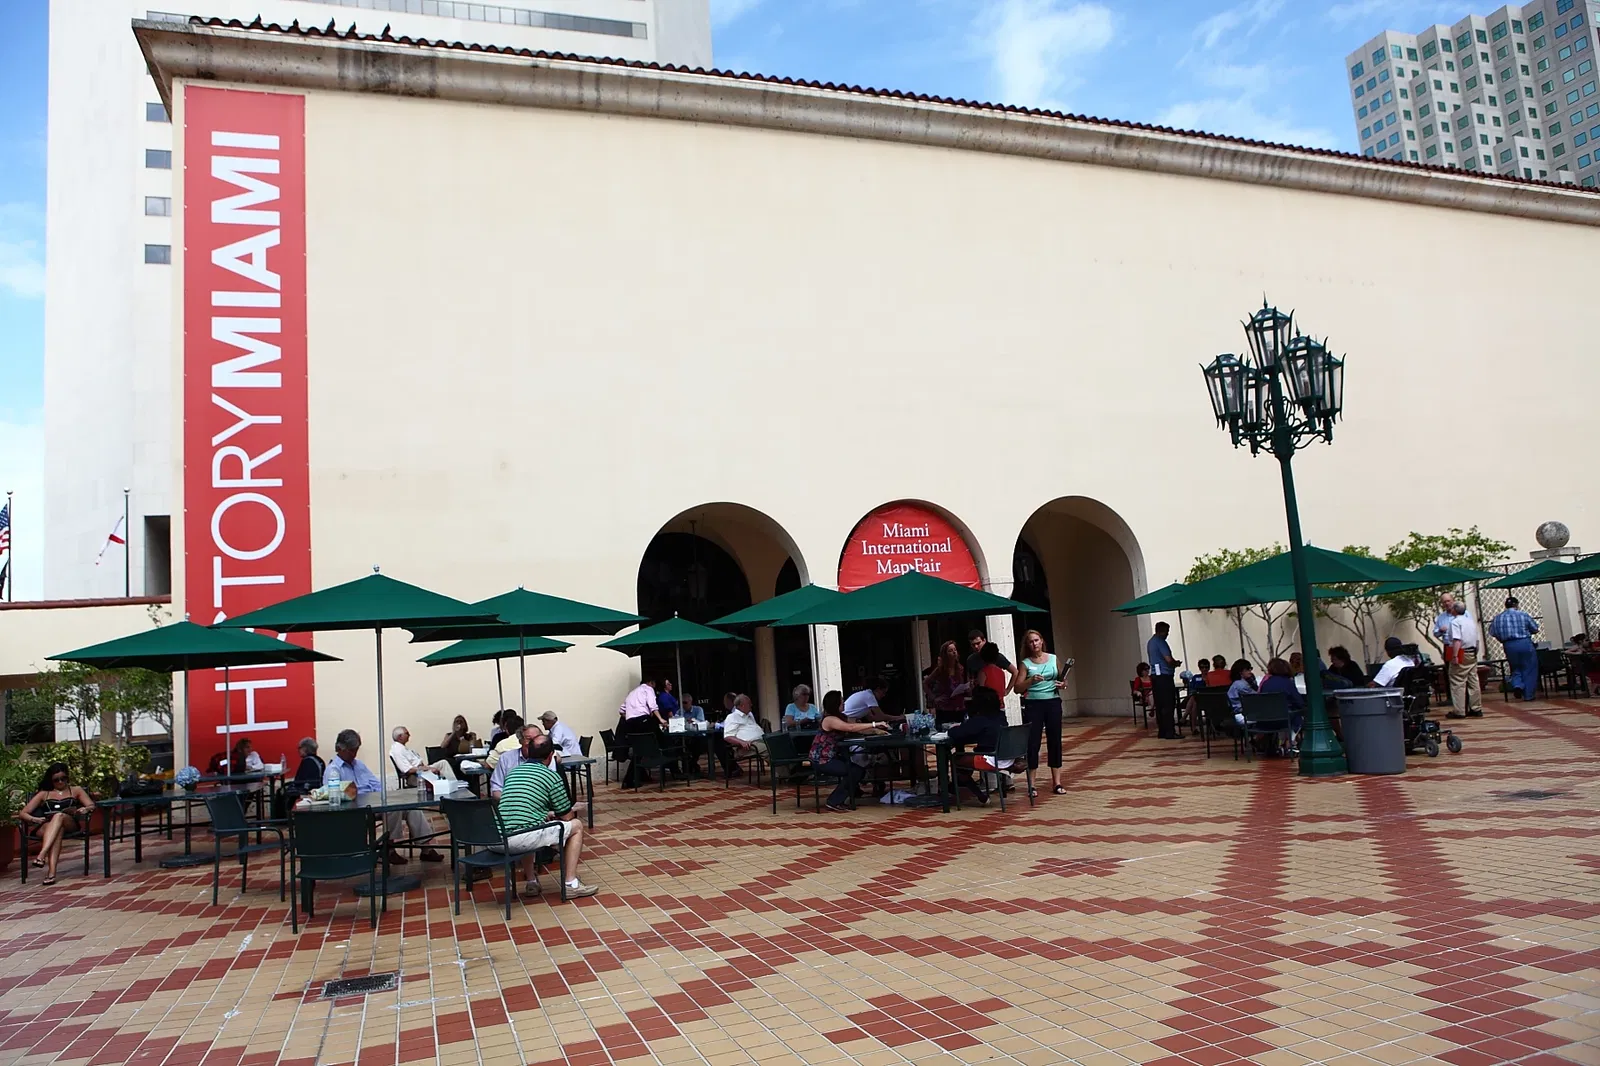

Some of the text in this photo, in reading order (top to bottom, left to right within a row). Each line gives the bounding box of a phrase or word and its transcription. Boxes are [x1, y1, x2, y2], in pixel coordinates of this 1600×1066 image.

[883, 523, 930, 538] Miami
[862, 537, 952, 555] International
[876, 557, 941, 575] Map Fair
